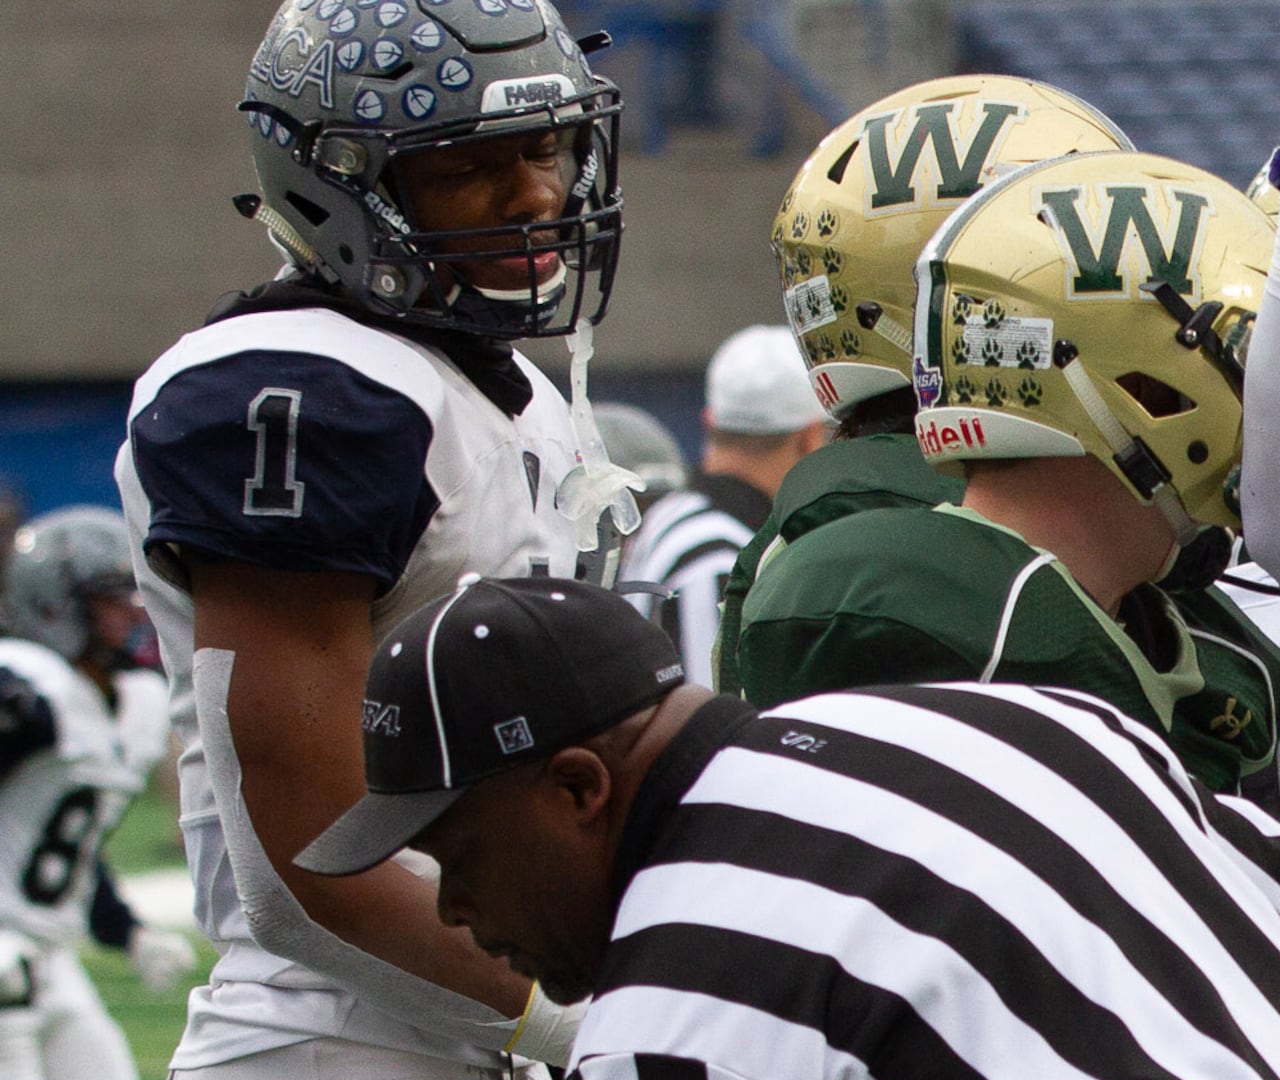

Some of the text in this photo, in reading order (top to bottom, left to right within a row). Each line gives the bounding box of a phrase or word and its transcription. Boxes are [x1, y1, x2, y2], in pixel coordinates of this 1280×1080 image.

[862, 102, 1022, 212] W
[1041, 186, 1209, 296] W
[243, 387, 305, 518] 1
[20, 783, 98, 908] 8
